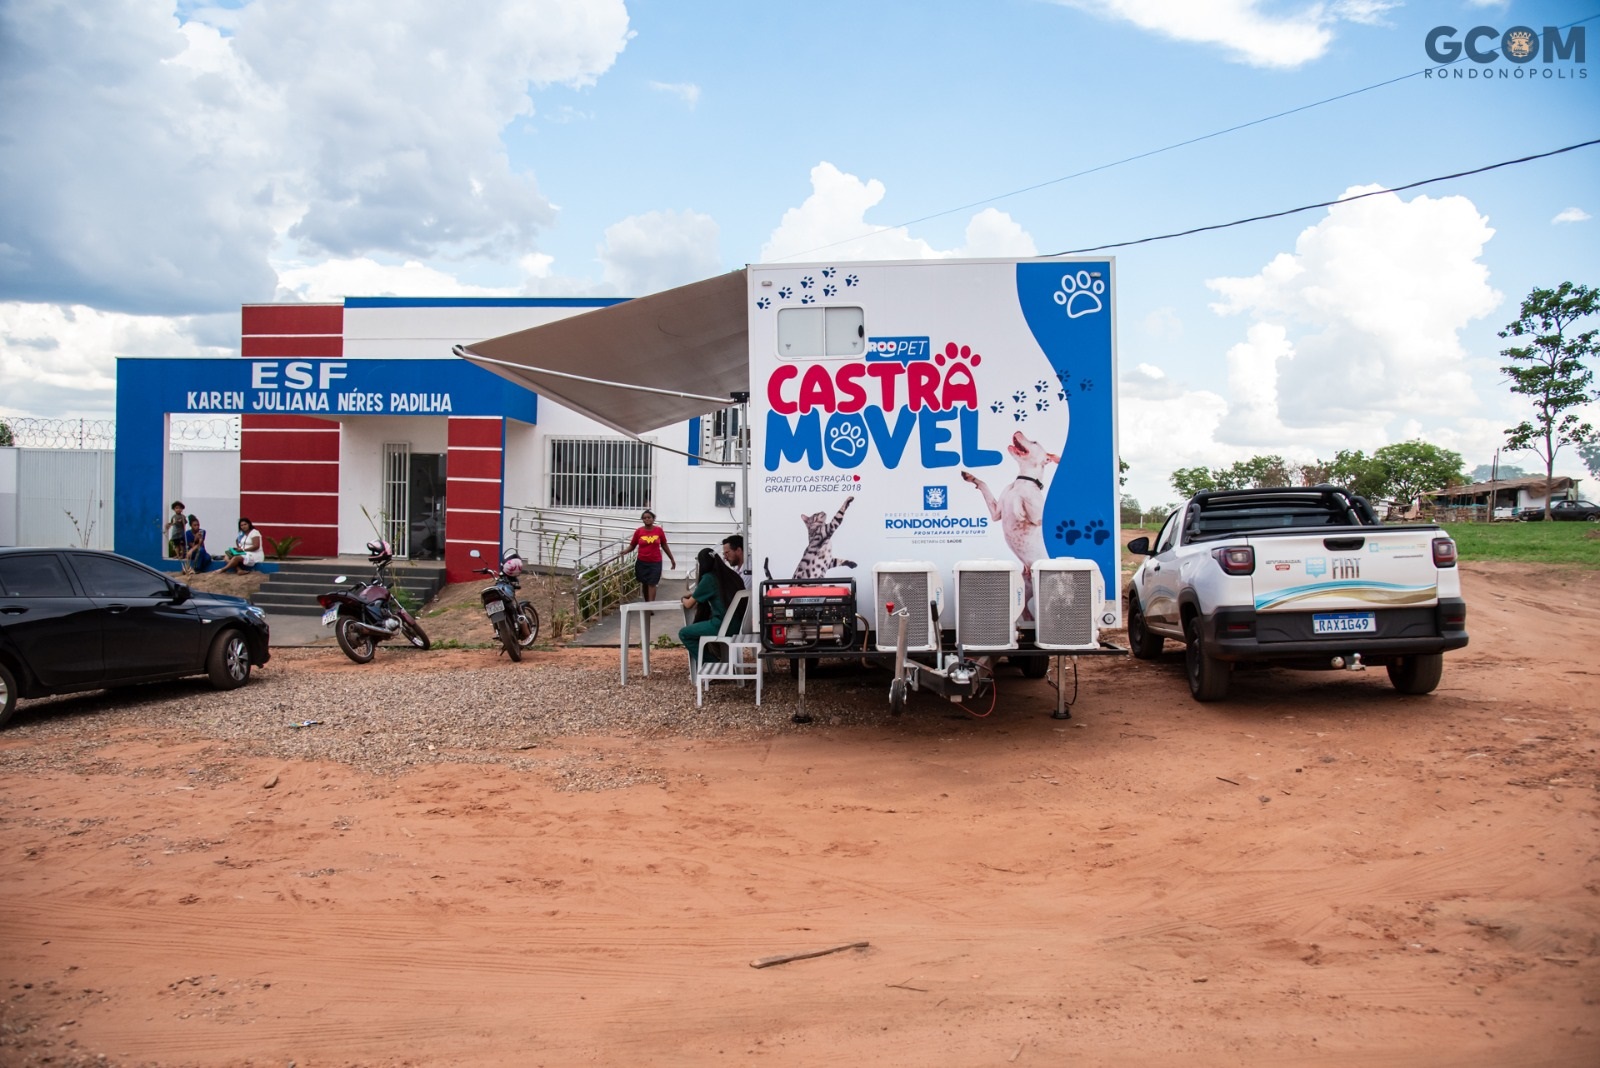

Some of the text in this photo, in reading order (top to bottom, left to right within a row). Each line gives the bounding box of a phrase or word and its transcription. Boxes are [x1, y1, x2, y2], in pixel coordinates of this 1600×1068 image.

[251, 362, 348, 390] ESF
[187, 387, 452, 412] KAREN JULIANA NÉRES PADILHA
[767, 361, 978, 415] CASTRA
[764, 404, 1004, 472] MOVEL
[764, 483, 862, 493] GRATUITA DESDE 2018
[765, 474, 852, 484] PROJETO CASTRAÇÃO
[885, 515, 988, 529] RONDONÓPOLIS
[1331, 557, 1361, 580] FIAT
[1318, 618, 1369, 632] RAX1G49
